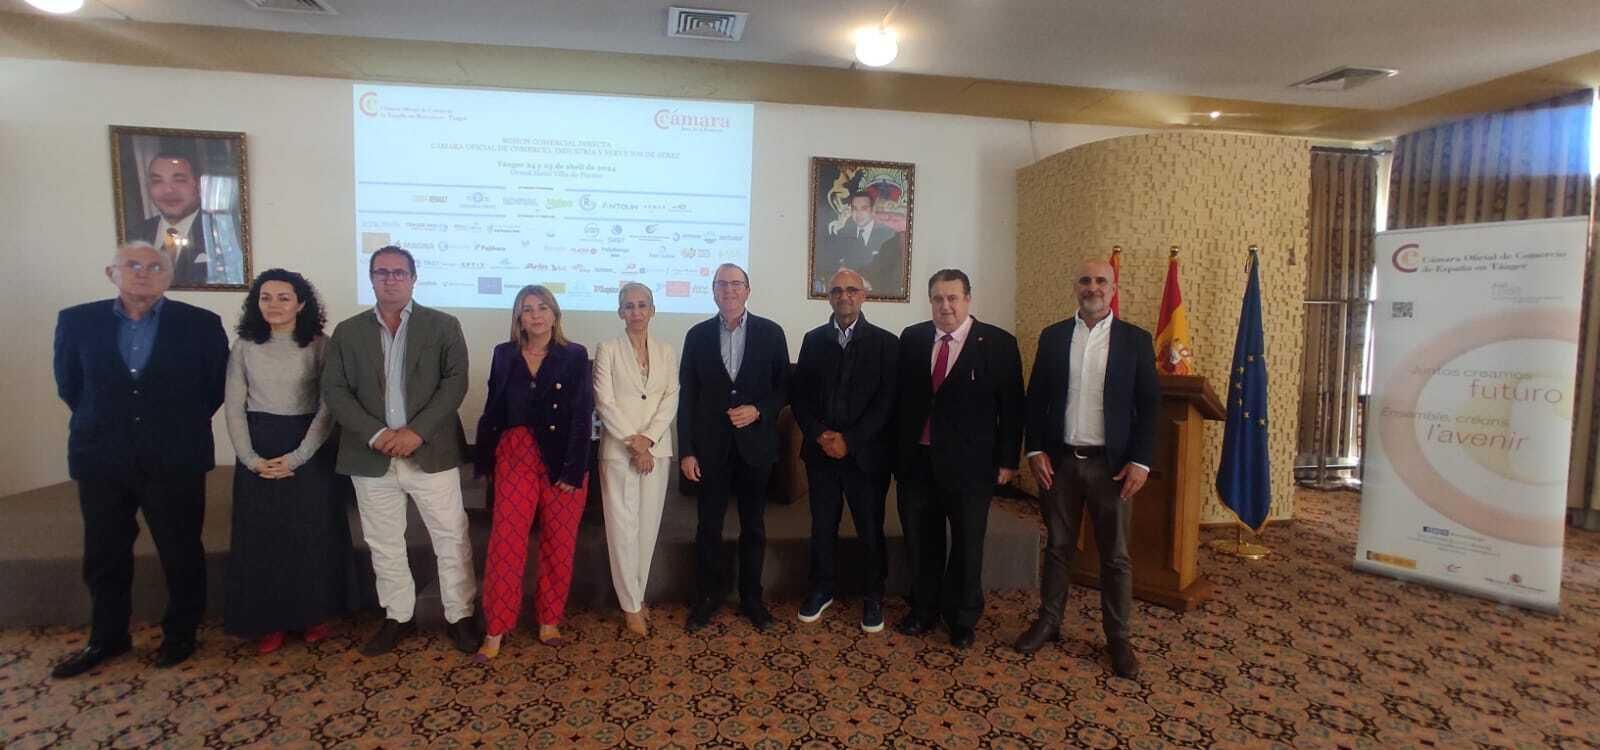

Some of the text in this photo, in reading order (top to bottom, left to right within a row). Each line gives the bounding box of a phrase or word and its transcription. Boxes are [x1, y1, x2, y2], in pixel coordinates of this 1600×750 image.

[1422, 250, 1567, 264] Cámara Oficial de Comercio
[1421, 263, 1433, 273] de
[1435, 262, 1472, 275] España
[1491, 262, 1528, 273] Tánger
[1410, 366, 1533, 380] Juntos creamos
[1465, 379, 1562, 404] futuro
[1426, 423, 1529, 450] l'avenir
